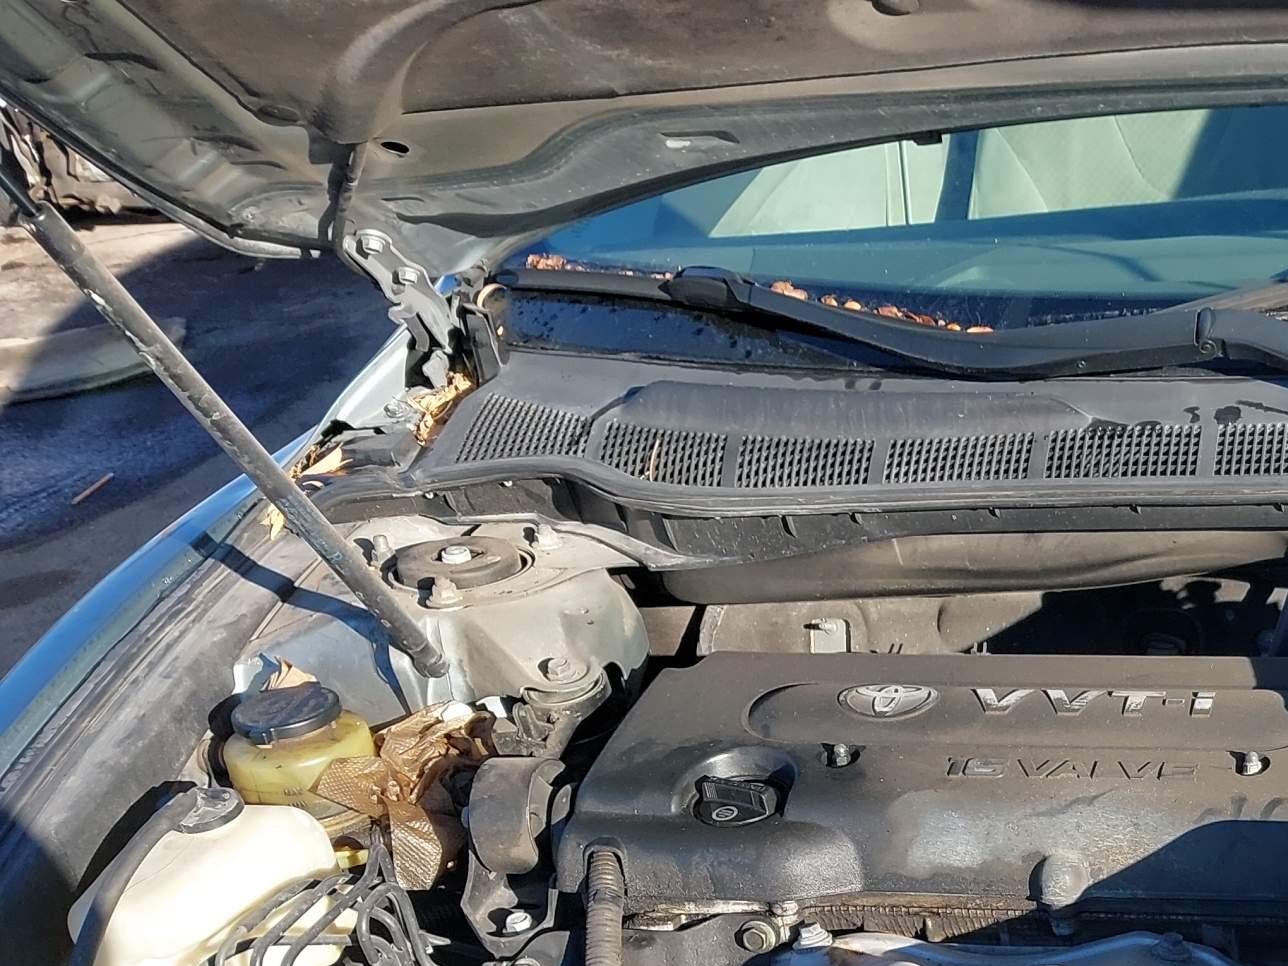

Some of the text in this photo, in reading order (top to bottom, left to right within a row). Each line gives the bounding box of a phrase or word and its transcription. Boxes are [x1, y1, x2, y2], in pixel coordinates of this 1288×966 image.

[970, 688, 1216, 718] VVT-i
[946, 756, 1199, 781] 16 VALVE
